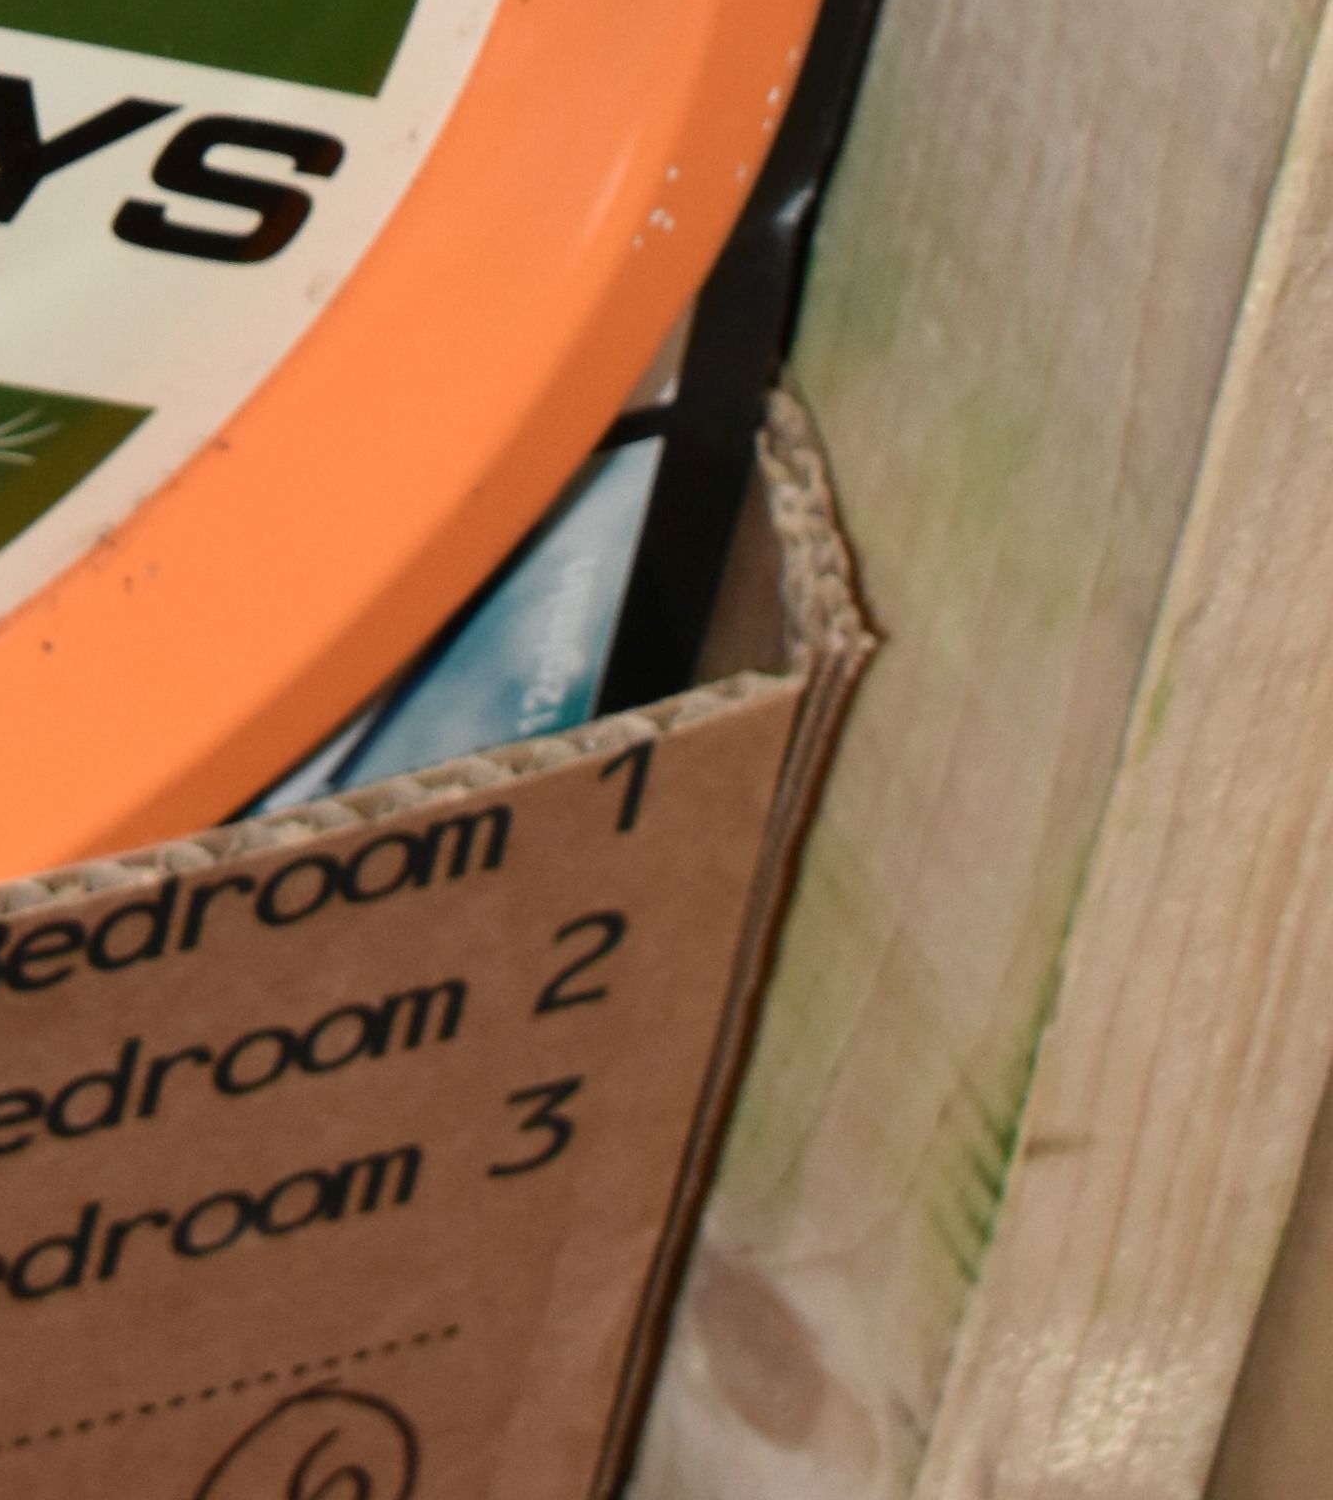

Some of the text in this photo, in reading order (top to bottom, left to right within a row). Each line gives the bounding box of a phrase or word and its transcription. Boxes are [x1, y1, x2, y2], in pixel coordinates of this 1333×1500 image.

[598, 740, 654, 834] 1
[534, 910, 627, 1017] 2
[489, 1077, 585, 1179] 3
